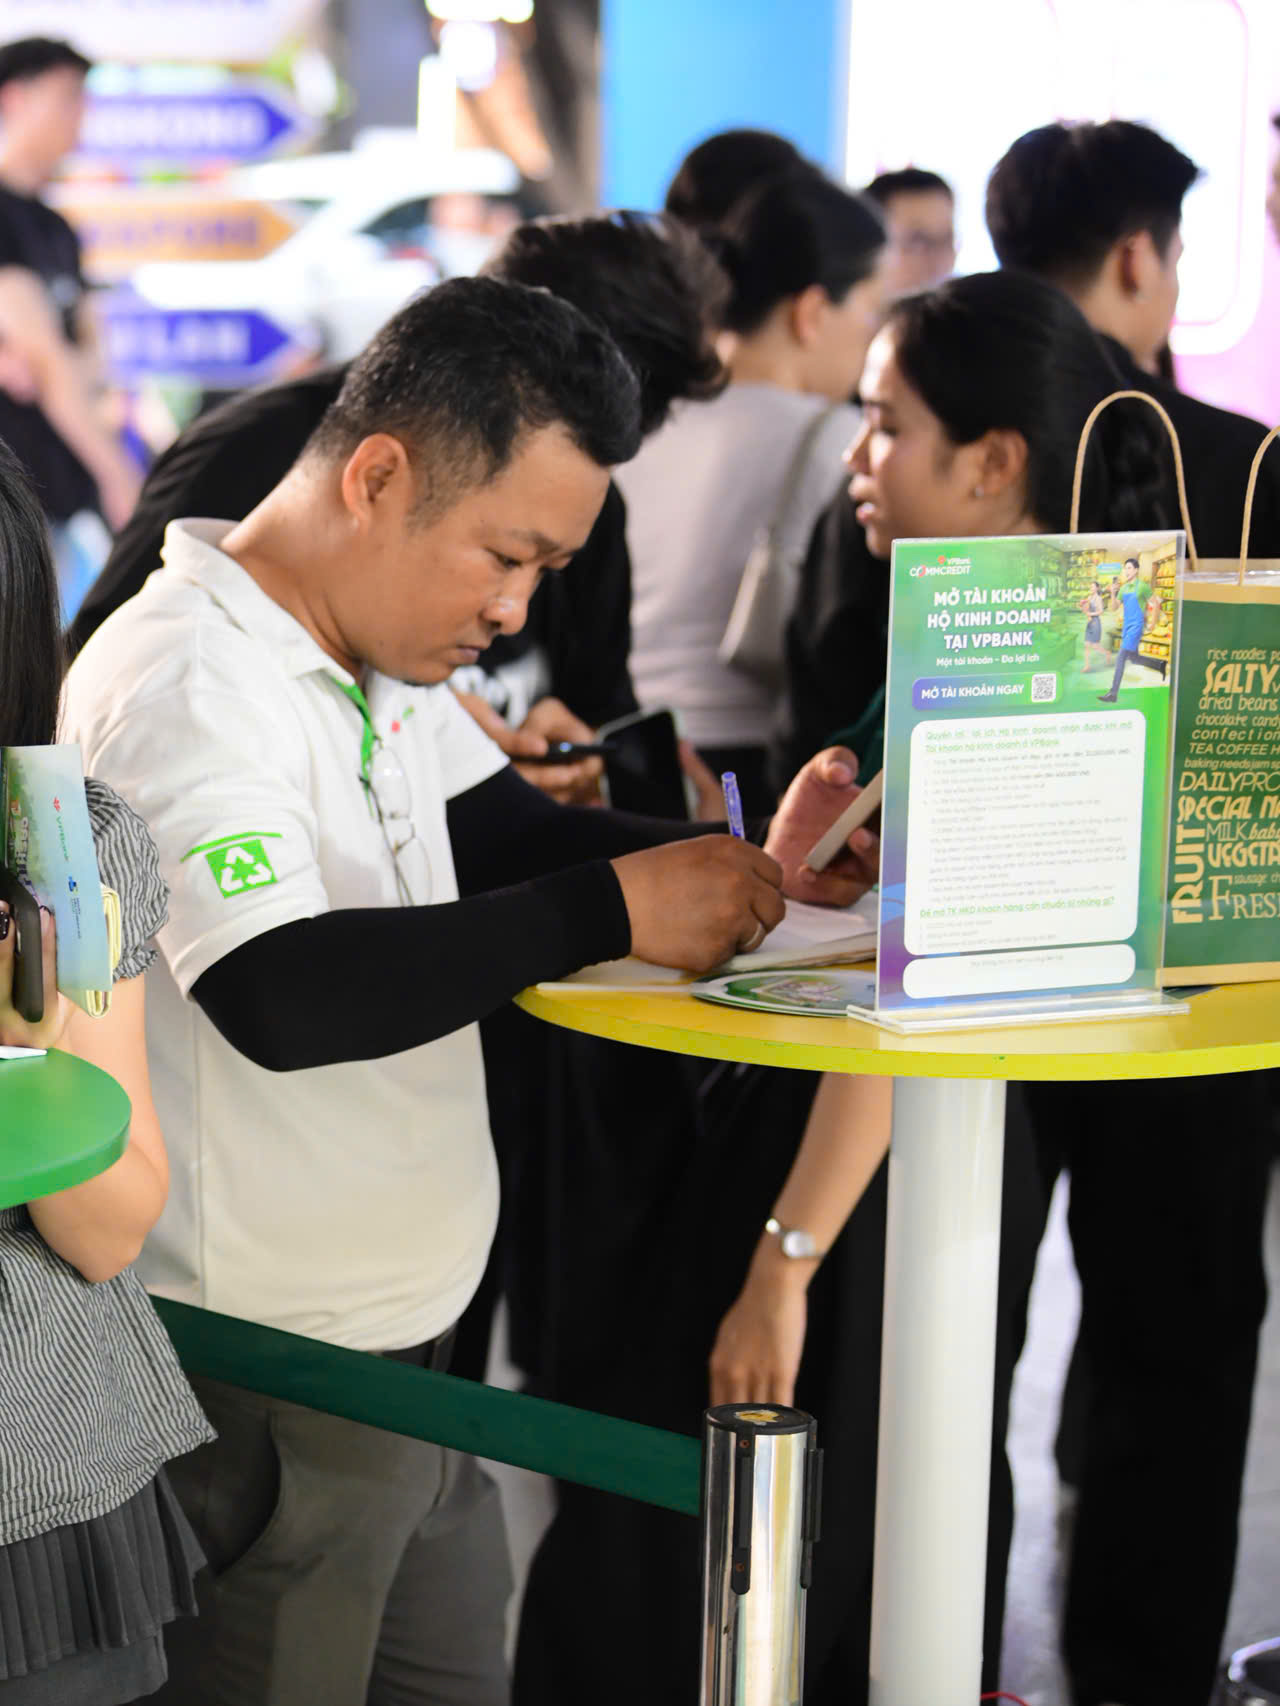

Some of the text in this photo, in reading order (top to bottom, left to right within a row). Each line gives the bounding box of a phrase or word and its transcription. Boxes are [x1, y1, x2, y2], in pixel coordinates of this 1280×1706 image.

[933, 583, 1047, 606] MỞ TÀI KHOẢN
[927, 608, 1051, 631] HỘ KINH DOANH
[943, 631, 1033, 652] TẠI VPBANK
[1202, 661, 1280, 694] SALTY
[941, 685, 956, 697] TÀI
[996, 684, 1024, 695] NGAY
[1199, 694, 1279, 711] dried beans
[1195, 713, 1249, 727] chocolate
[1189, 742, 1214, 754] TEA
[1216, 743, 1269, 755] COFFEE
[1177, 795, 1252, 823] SPECIAL
[1206, 821, 1248, 842] MILK
[1171, 824, 1205, 924] FRUIT
[1208, 875, 1280, 920] FRES
